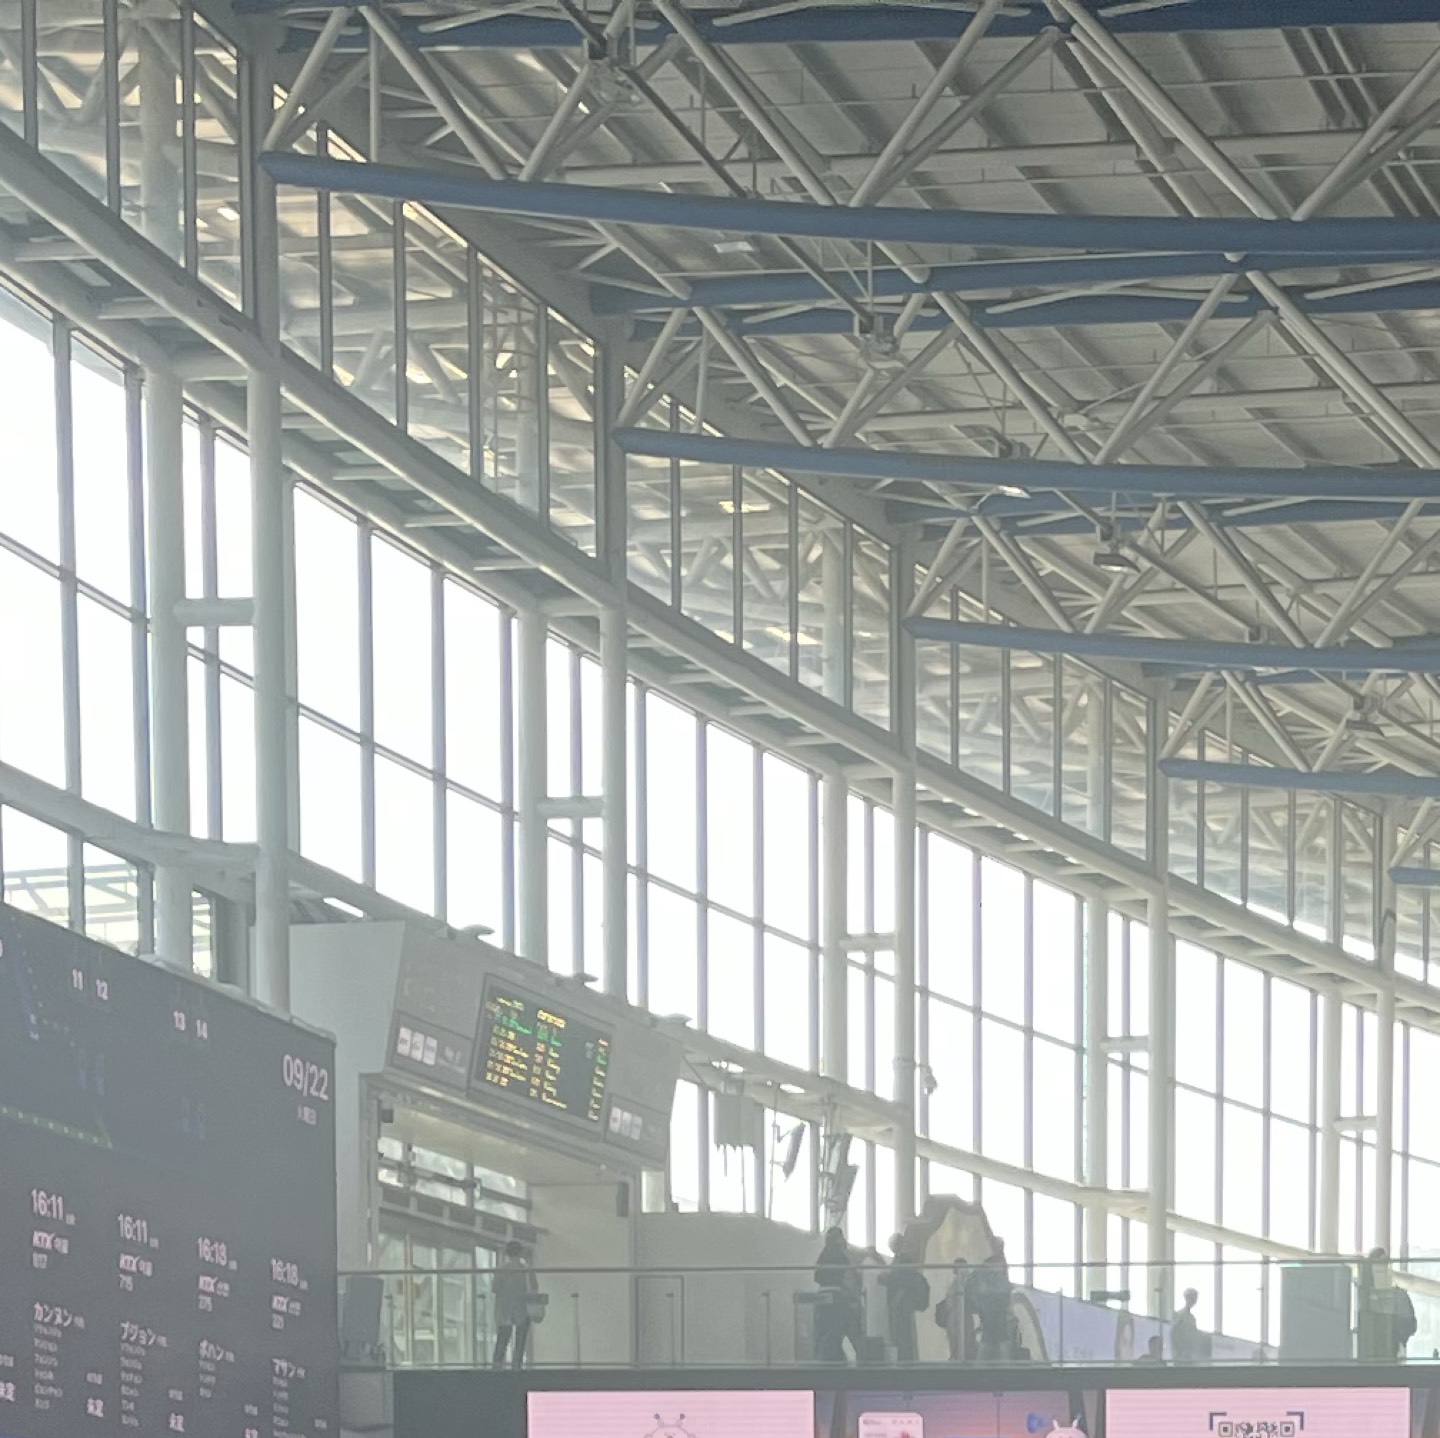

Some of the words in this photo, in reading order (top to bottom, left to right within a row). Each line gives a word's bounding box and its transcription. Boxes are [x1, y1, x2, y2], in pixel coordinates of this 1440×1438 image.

[72, 969, 84, 990] 11
[96, 979, 109, 1000] 12
[195, 1019, 209, 1041] 14
[282, 1053, 329, 1101] 09/22
[31, 1188, 64, 1221] 16:11
[118, 1213, 148, 1244] 16:11
